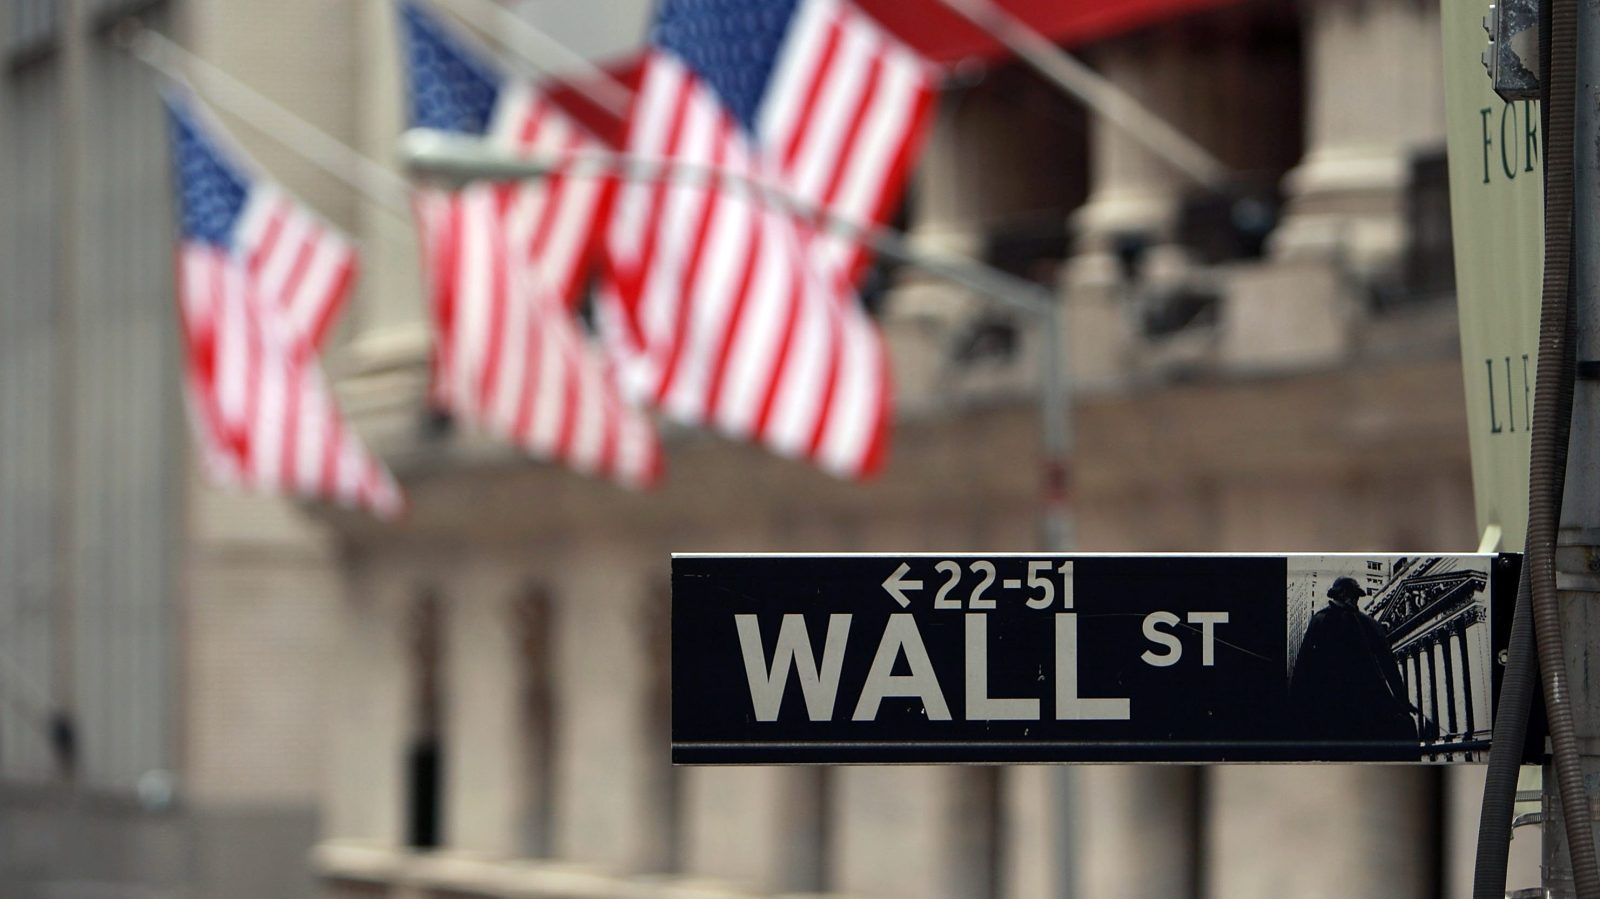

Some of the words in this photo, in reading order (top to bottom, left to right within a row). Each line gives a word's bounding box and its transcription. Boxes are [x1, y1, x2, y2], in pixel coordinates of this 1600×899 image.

[934, 560, 1074, 610] 22-51
[735, 612, 1131, 721] WALL
[1140, 611, 1229, 667] ST
